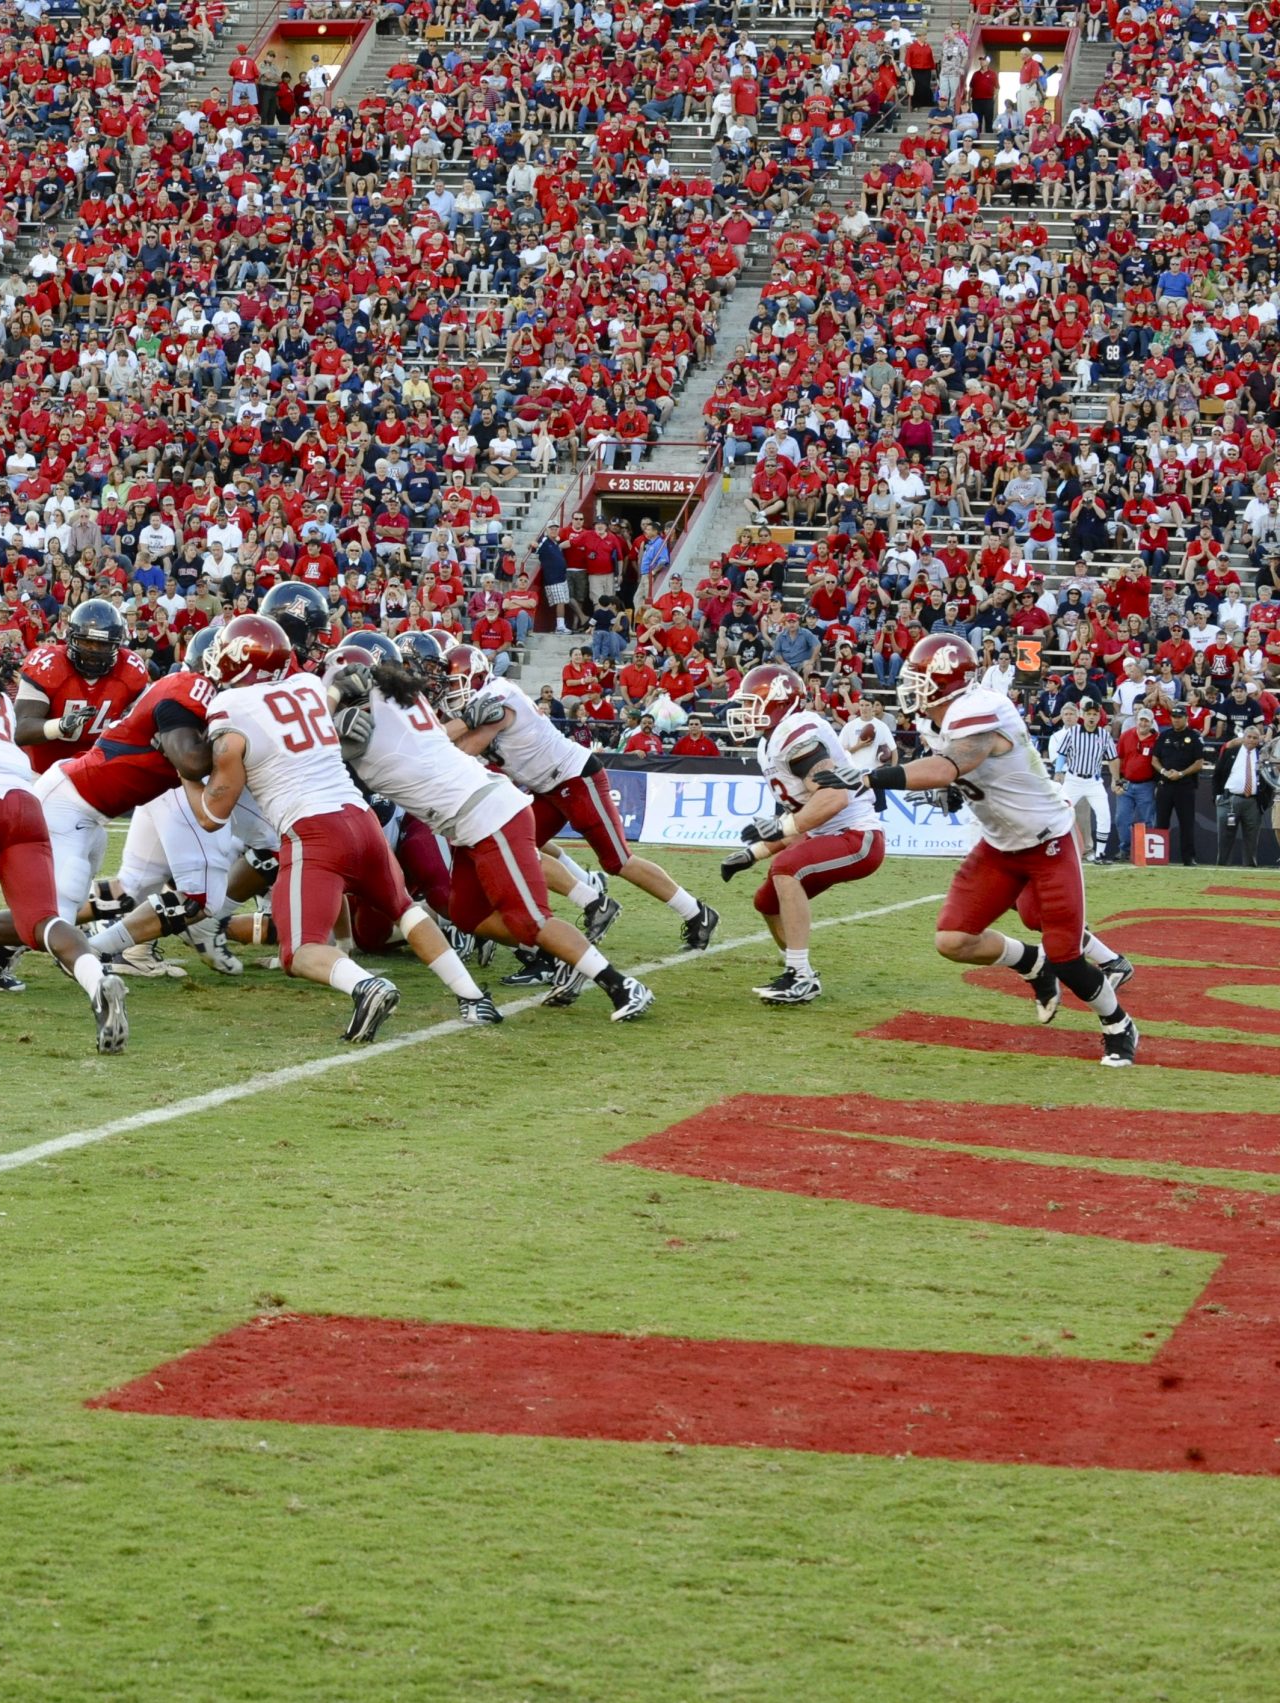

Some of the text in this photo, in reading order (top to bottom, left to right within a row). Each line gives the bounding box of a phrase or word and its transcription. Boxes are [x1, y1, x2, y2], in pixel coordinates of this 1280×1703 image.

[239, 59, 248, 75] 7
[1106, 345, 1120, 361] 68
[618, 479, 684, 492] 23 SECTION 24
[27, 648, 56, 671] 54
[1016, 640, 1042, 672] 3
[189, 678, 217, 708] 88
[264, 687, 340, 753] 92
[667, 781, 964, 826] HUNA
[908, 835, 917, 848] it
[925, 837, 965, 849] most
[1144, 833, 1165, 859] G
